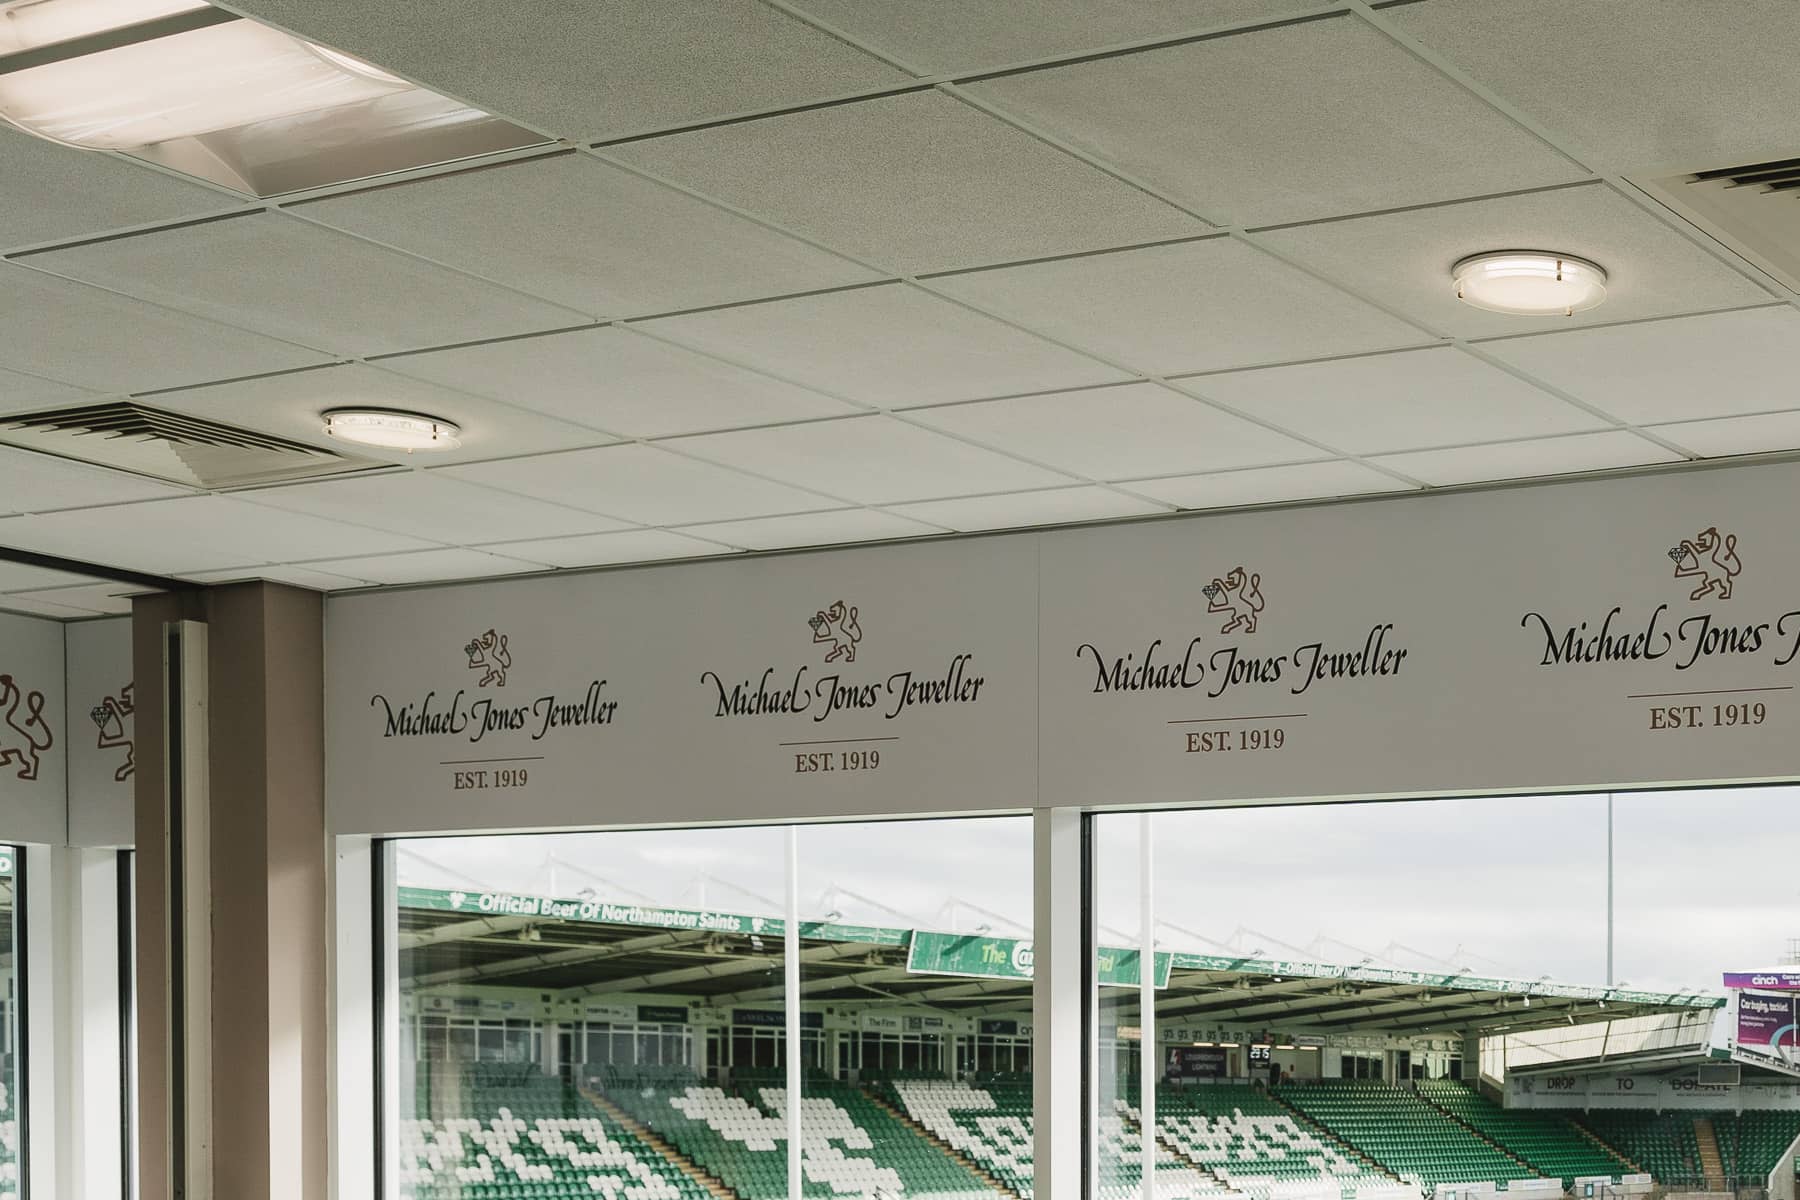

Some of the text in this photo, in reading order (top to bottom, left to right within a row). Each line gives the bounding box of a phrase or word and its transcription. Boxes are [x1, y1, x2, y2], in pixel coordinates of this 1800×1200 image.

[1521, 604, 1671, 667] Michael
[1676, 613, 1768, 671] Jones
[1077, 623, 1409, 699] Michael Jones Jeweller
[700, 654, 984, 723] Michael Jones Jeweller
[371, 680, 618, 742] Michael Jones Jeweller
[1649, 701, 1766, 730] EST. 1919
[1184, 728, 1285, 754] EST. 1919
[794, 750, 880, 773] EST. 1919
[454, 767, 528, 790] EST. 1919
[478, 894, 538, 915] Official
[540, 899, 579, 918] Beer
[601, 904, 698, 927] Northampton
[699, 914, 741, 931] Saints
[982, 945, 1006, 964] The
[1752, 974, 1778, 985] cinch
[1547, 1077, 1575, 1090] DROP
[1616, 1077, 1634, 1090] TO
